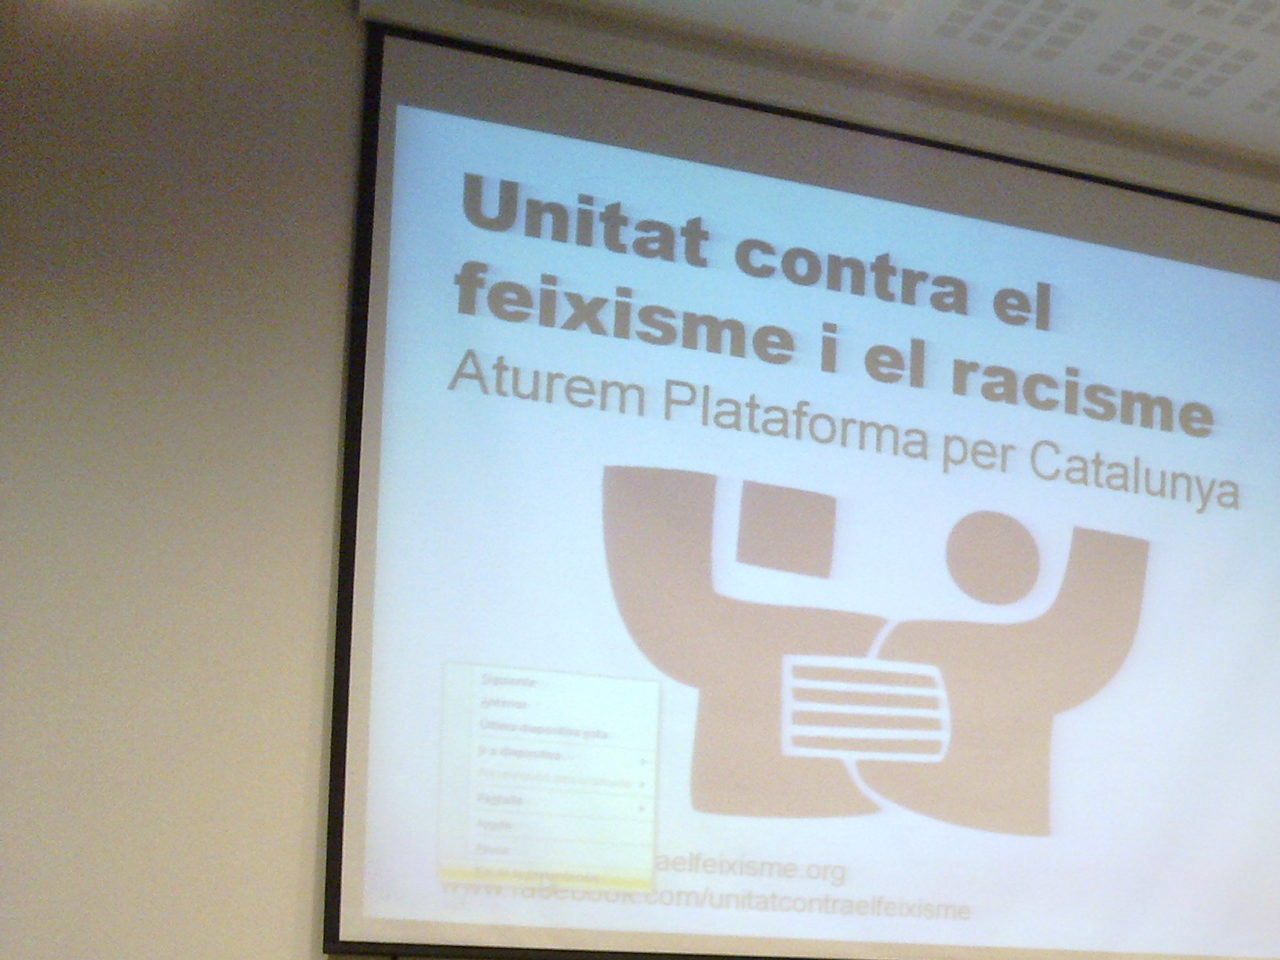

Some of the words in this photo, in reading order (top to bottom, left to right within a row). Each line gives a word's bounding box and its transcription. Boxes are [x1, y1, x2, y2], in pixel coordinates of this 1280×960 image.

[462, 172, 709, 269] Unitat
[734, 230, 969, 315] contra
[992, 282, 1052, 332] el
[447, 348, 646, 417] Aturem
[665, 379, 929, 461] Plataforma
[942, 430, 1016, 475] per
[1030, 439, 1242, 513] Catalunya
[454, 261, 796, 366] feixisme
[820, 322, 839, 374] i
[864, 338, 925, 389] el
[951, 354, 1216, 438] racisme
